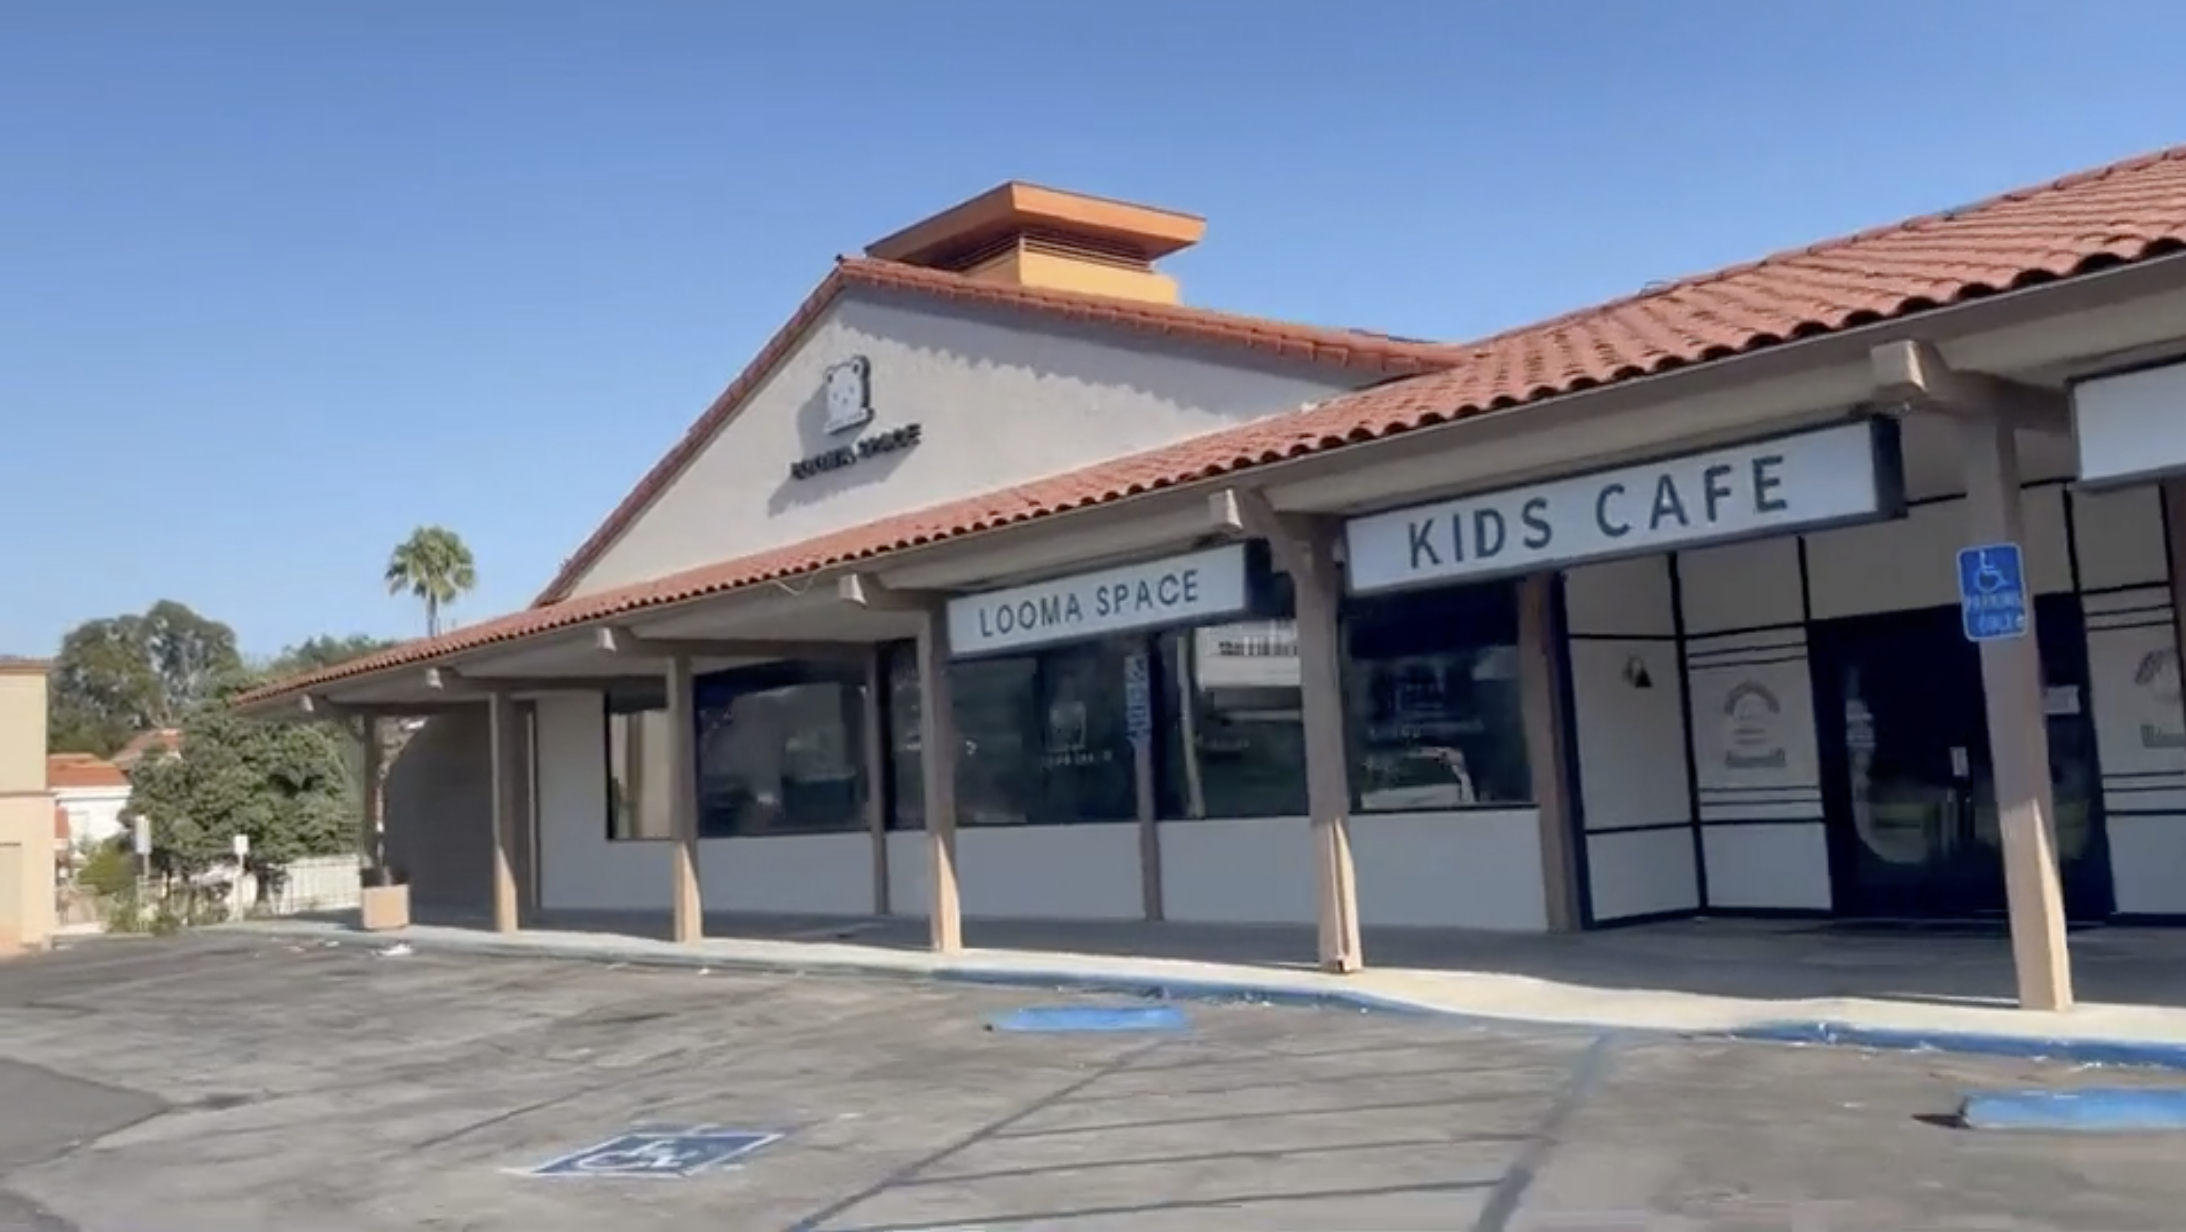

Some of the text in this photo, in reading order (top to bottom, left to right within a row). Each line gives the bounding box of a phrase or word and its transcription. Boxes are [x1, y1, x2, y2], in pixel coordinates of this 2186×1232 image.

[1408, 454, 1789, 569] KIDS CAFE
[979, 568, 1199, 638] LOOMA SPACE
